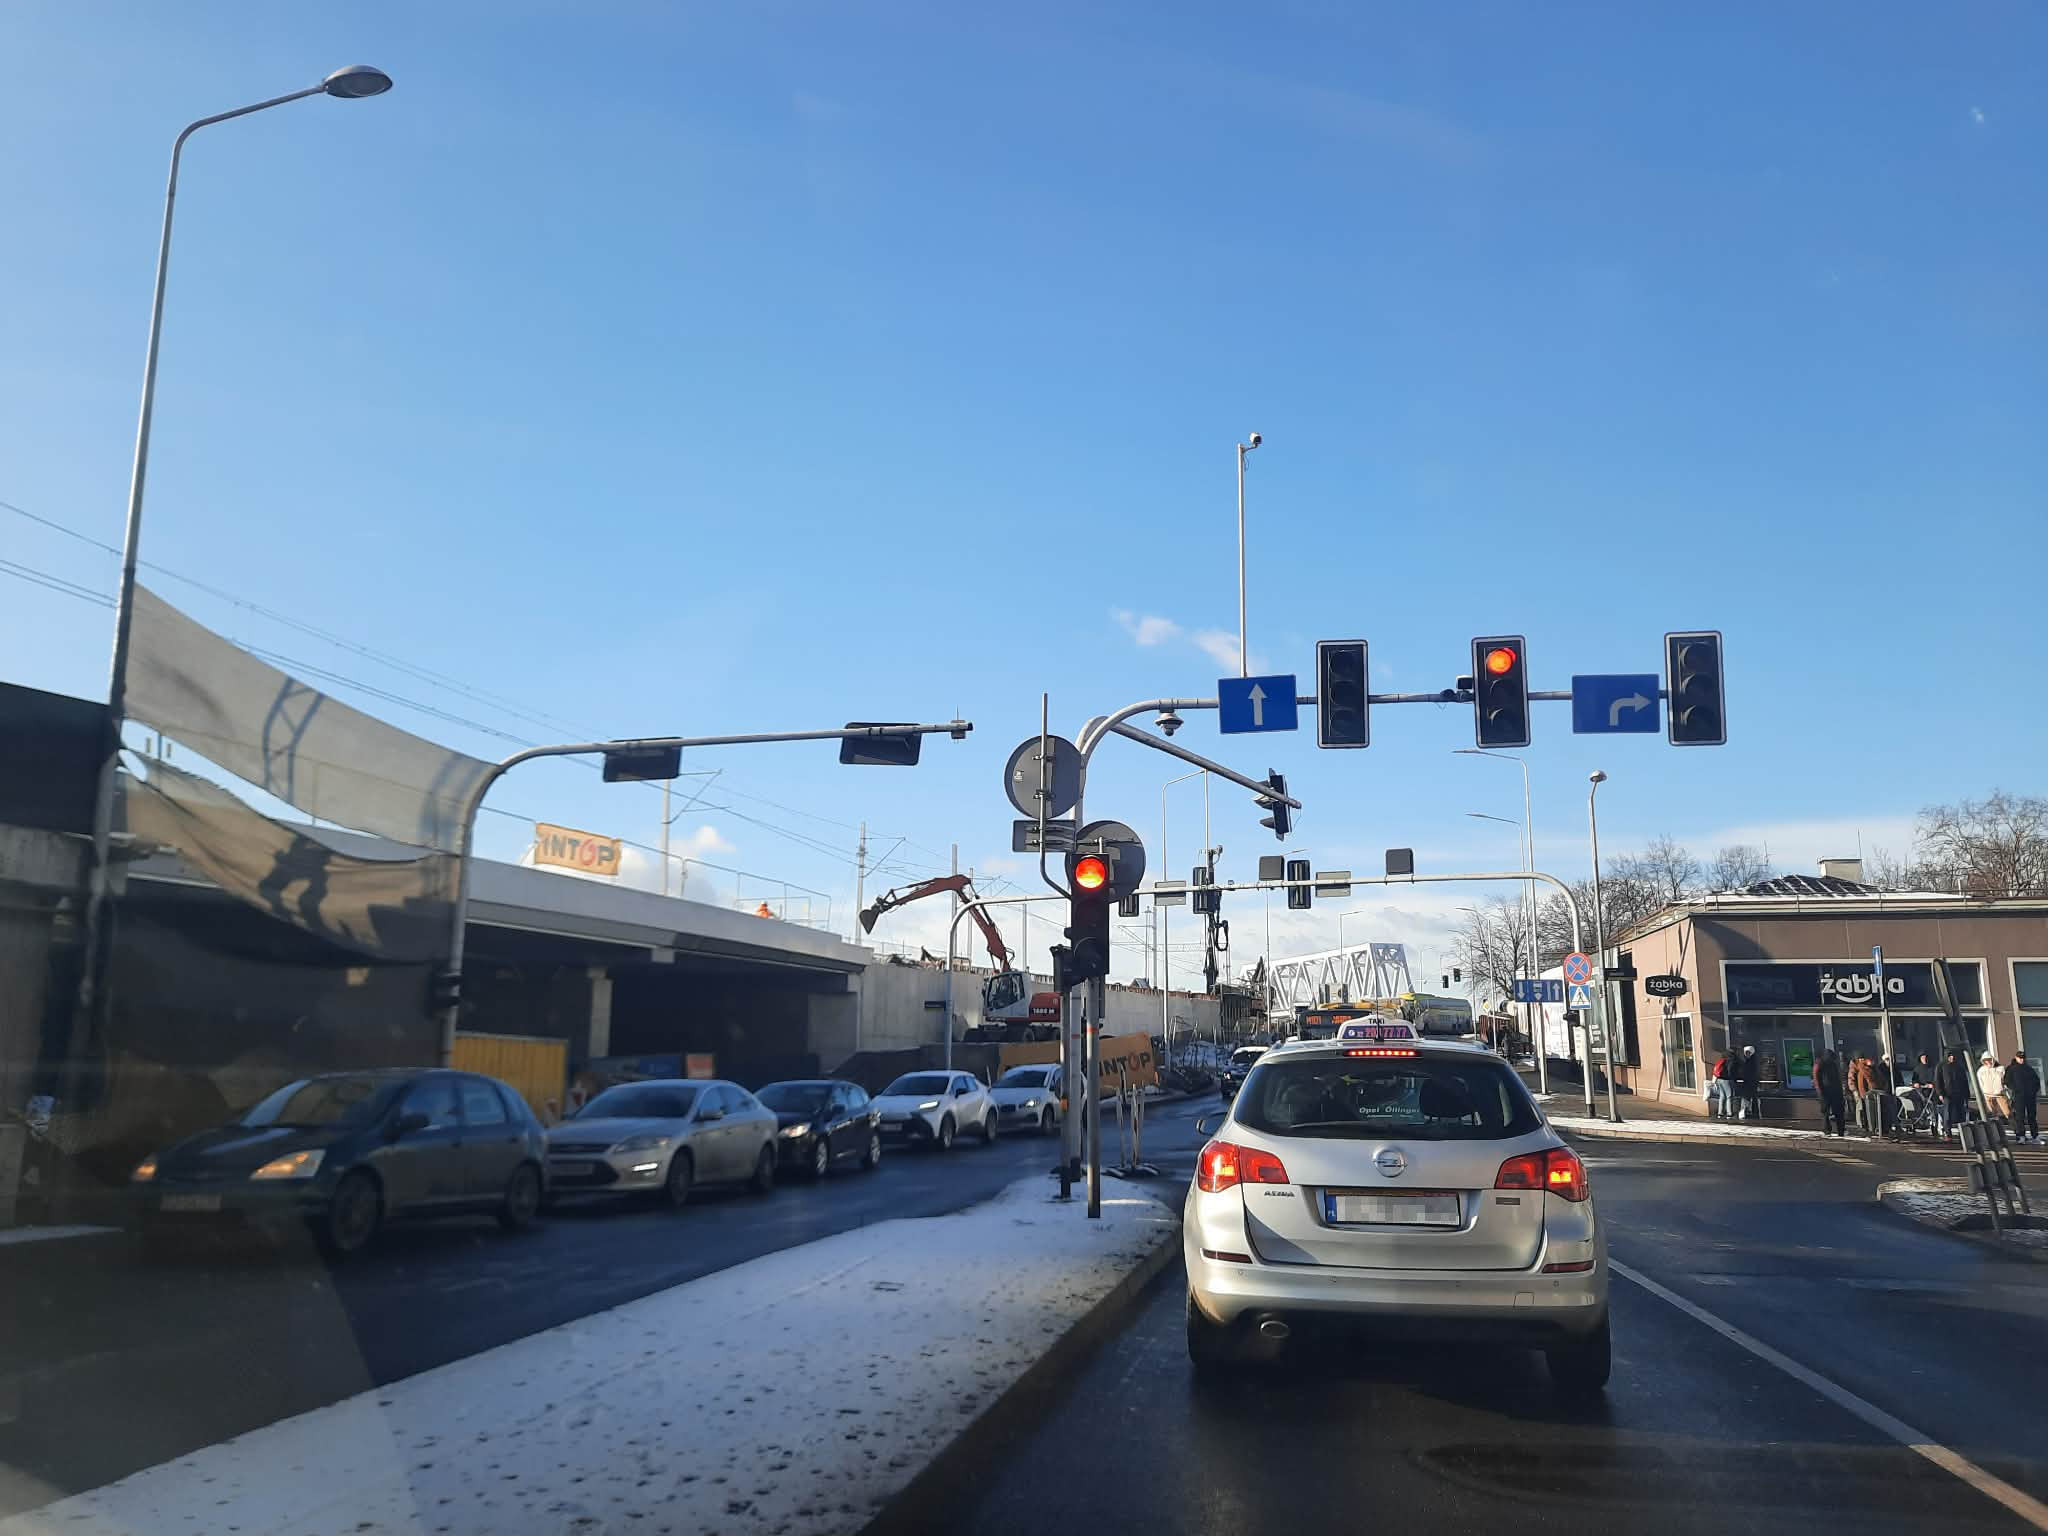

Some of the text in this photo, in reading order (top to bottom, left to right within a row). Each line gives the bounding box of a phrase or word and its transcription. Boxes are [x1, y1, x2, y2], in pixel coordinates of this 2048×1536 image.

[543, 834, 614, 866] INTOP
[1650, 979, 1683, 989] żabka
[1359, 1106, 1380, 1114] Opel
